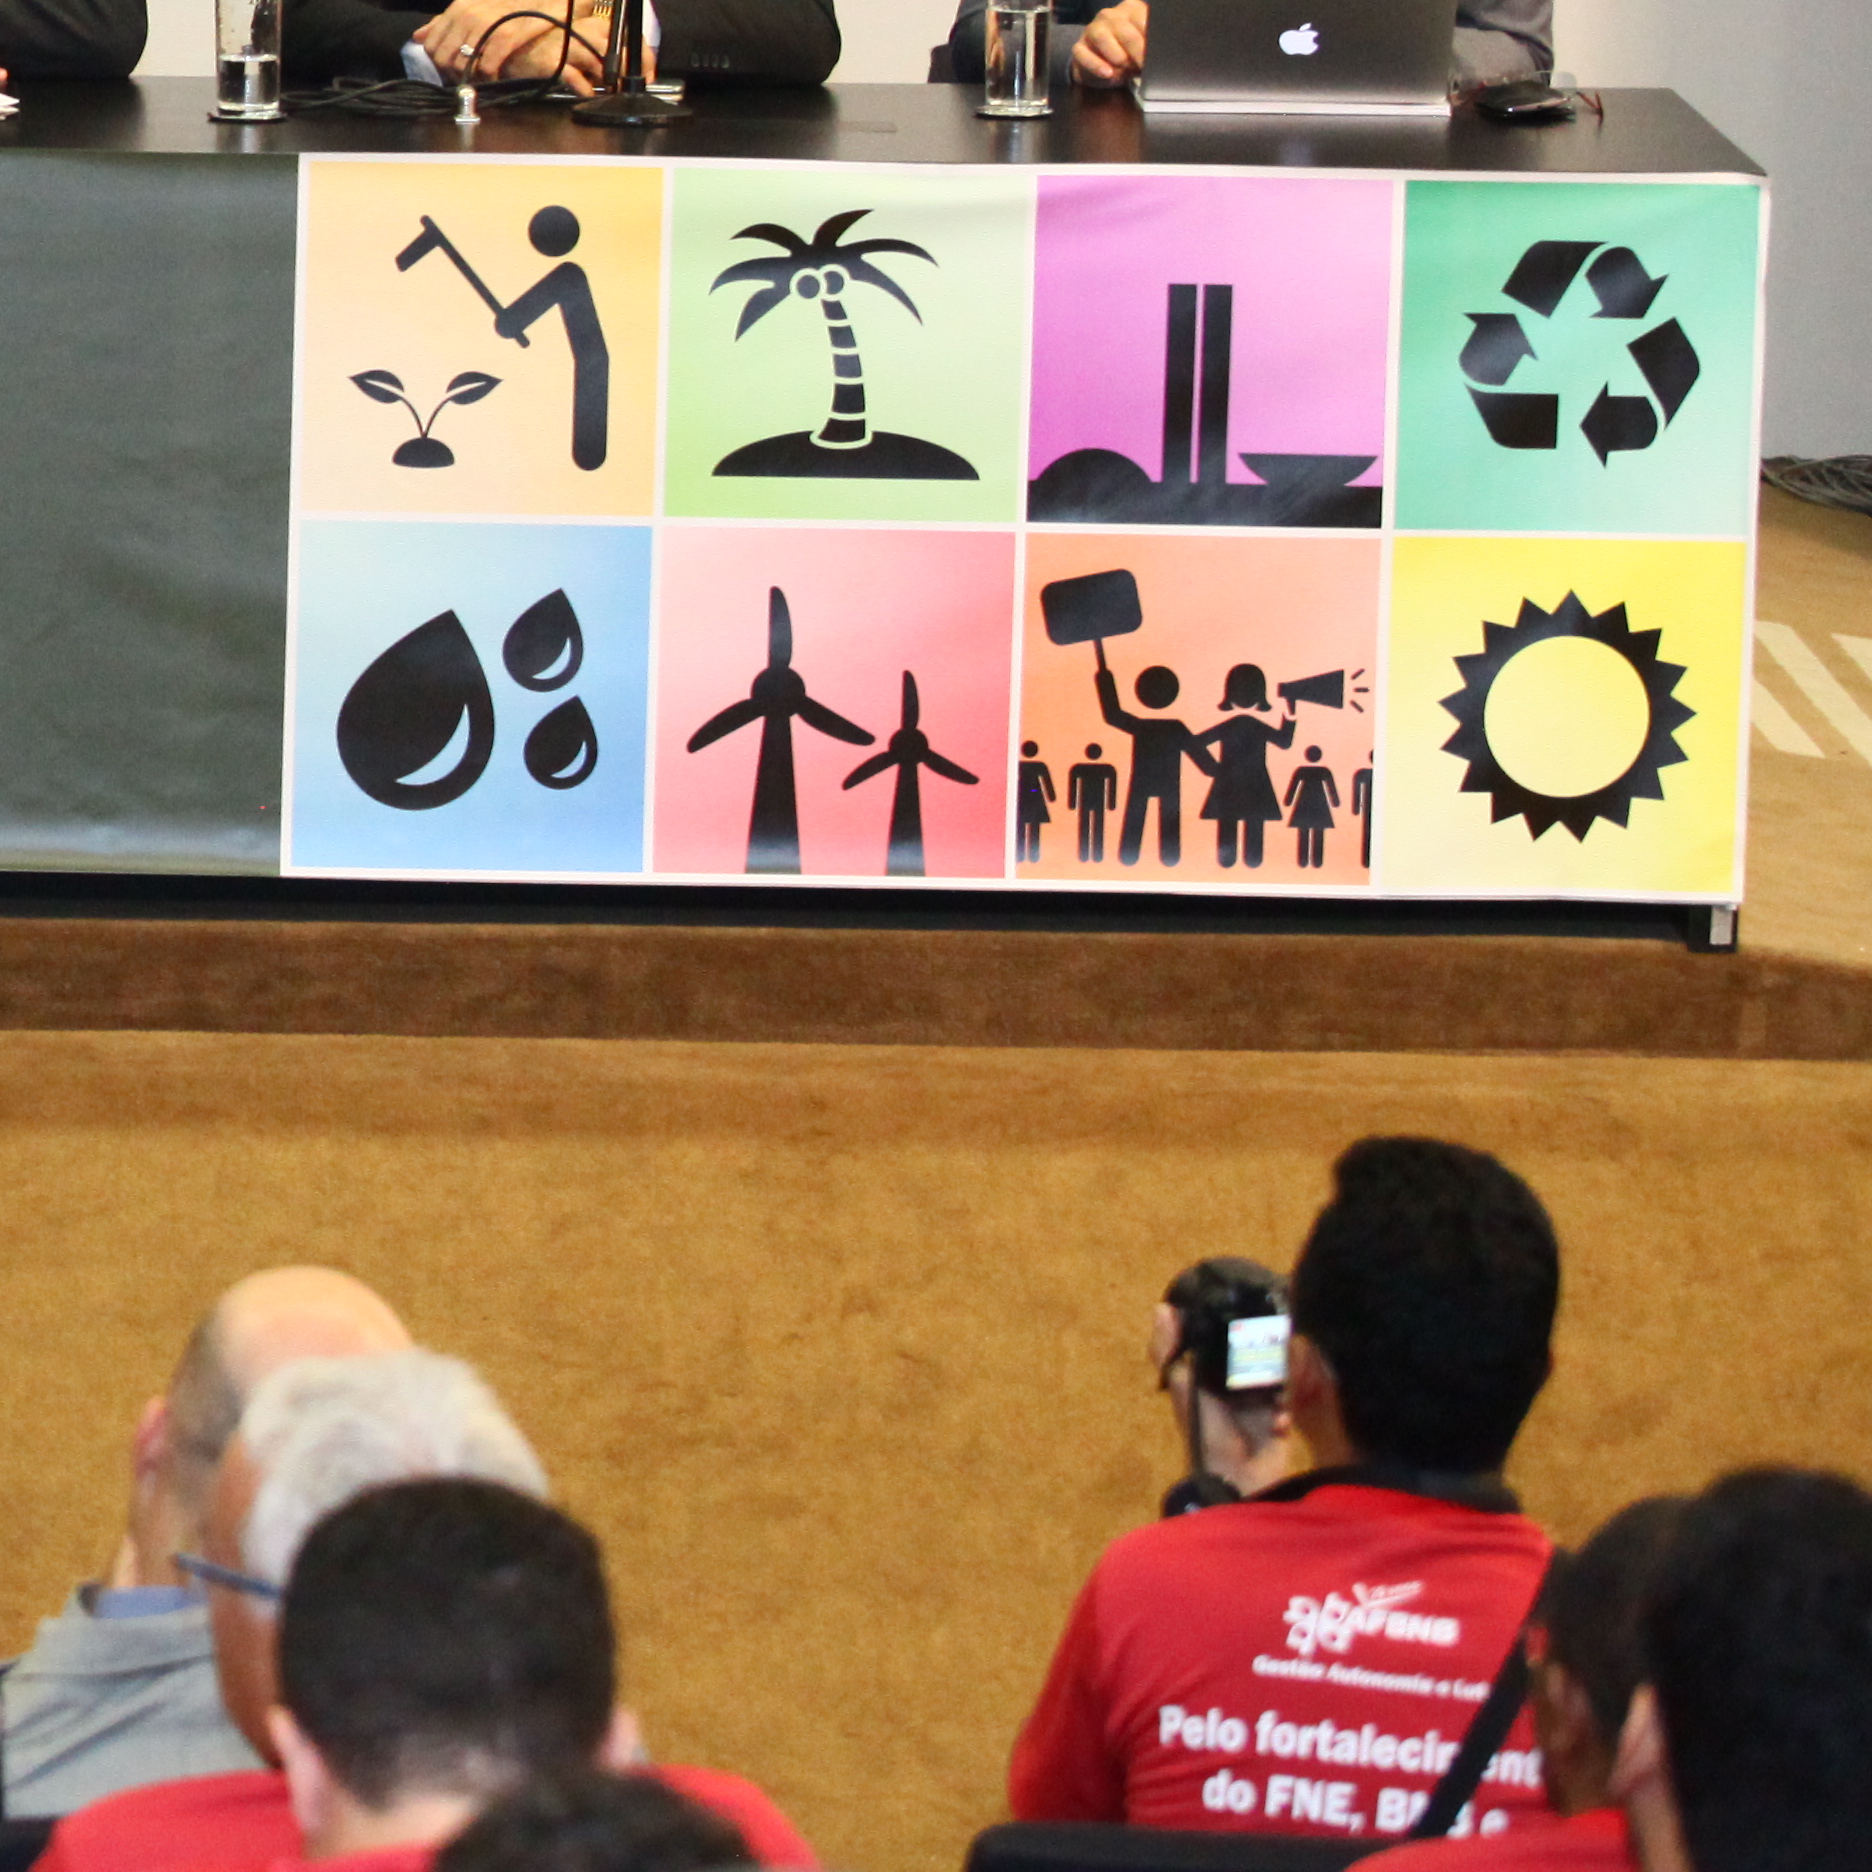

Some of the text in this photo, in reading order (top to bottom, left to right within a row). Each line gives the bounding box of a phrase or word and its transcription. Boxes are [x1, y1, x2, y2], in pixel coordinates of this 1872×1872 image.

[1158, 1704, 1542, 1788] Pelo fortalecient
[1201, 1768, 1256, 1814] do
[1264, 1773, 1367, 1834] FNE,
[1479, 1808, 1509, 1838] e
